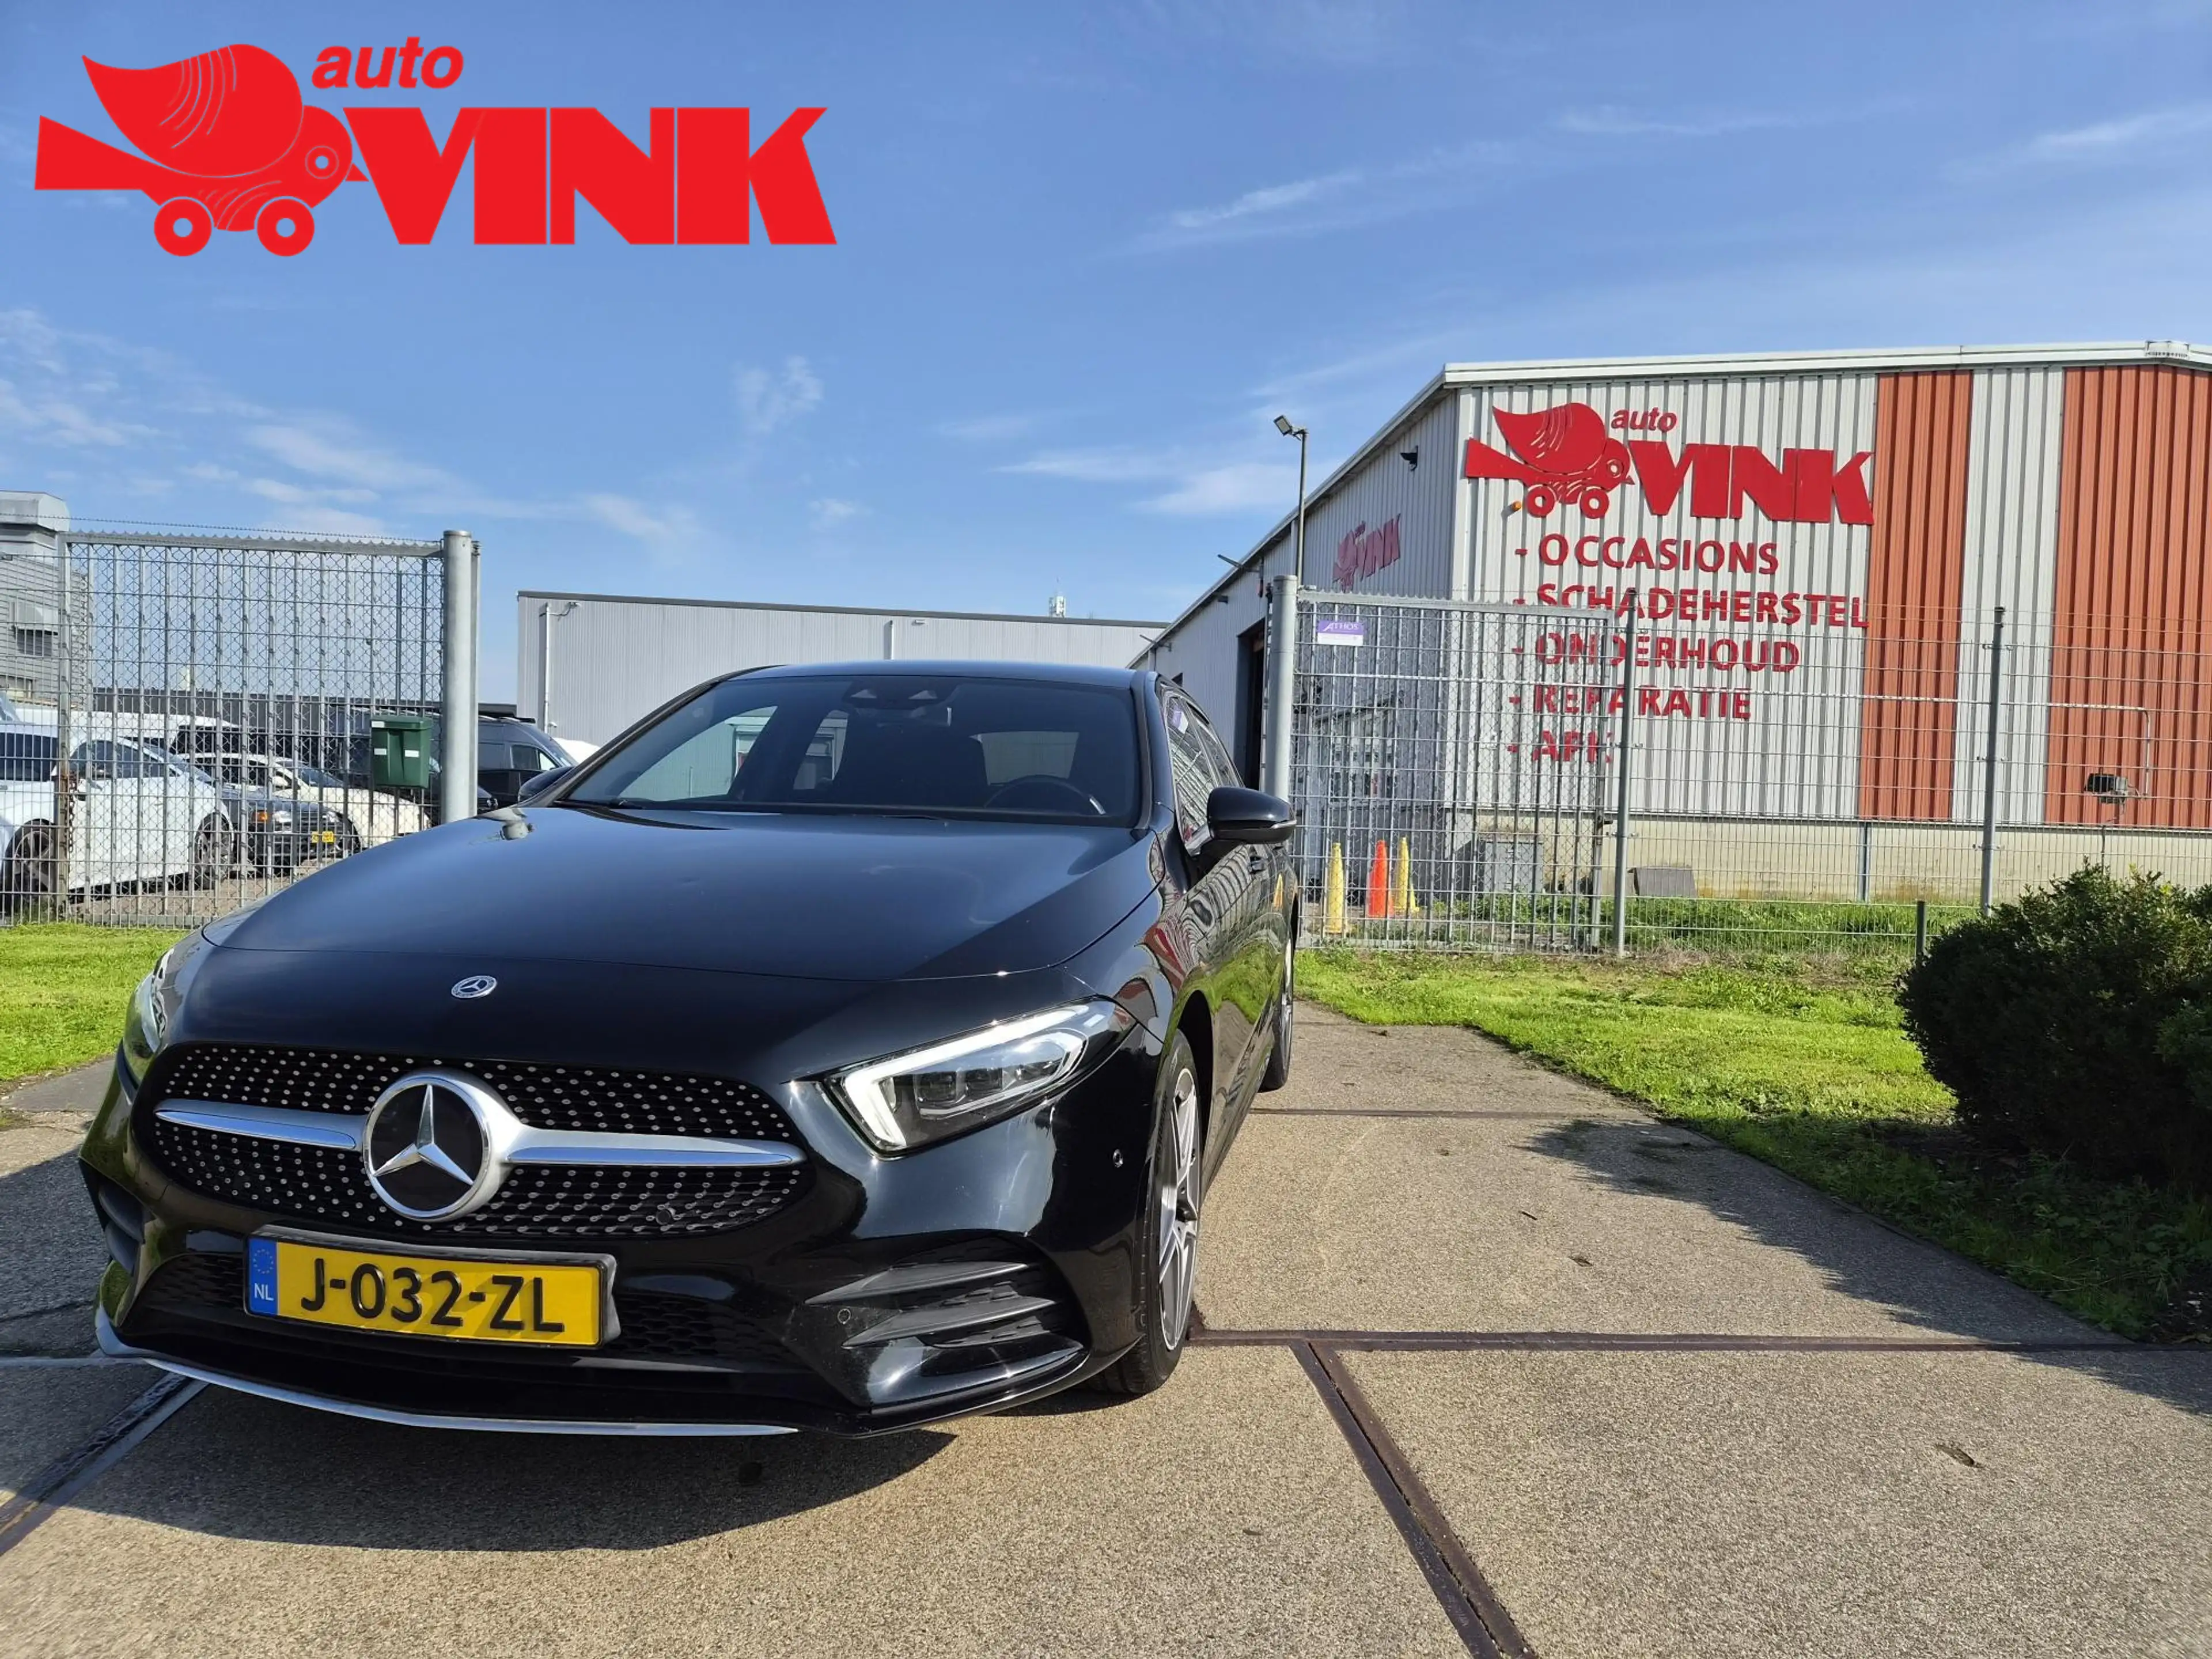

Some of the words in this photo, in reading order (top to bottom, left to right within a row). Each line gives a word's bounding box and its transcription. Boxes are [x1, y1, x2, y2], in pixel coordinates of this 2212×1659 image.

[1611, 407, 1677, 433] auto
[1628, 440, 1874, 525] VINK
[1539, 533, 1779, 574] OCCASIONS
[1537, 583, 1869, 628] SCHADEHERSTEL
[1536, 632, 1800, 672] ONDERHOUD
[1533, 684, 1751, 719] REPARATIE
[254, 1283, 274, 1302] NL
[300, 1257, 565, 1333] J-032-ZL
